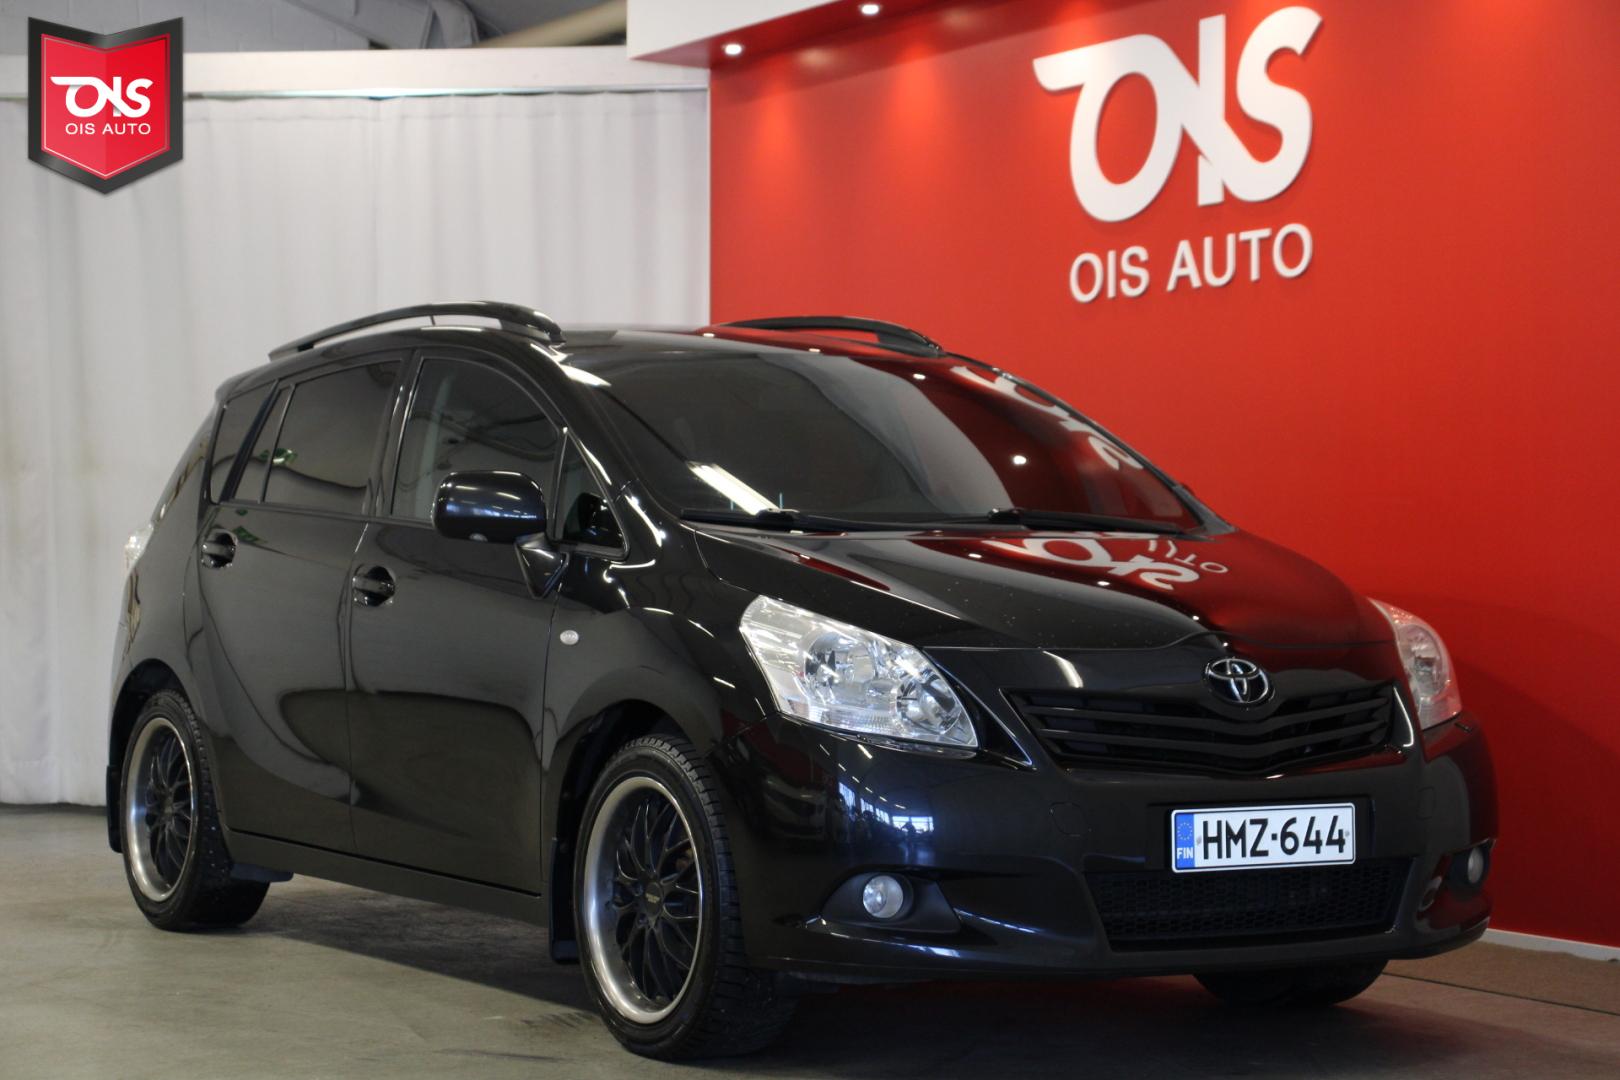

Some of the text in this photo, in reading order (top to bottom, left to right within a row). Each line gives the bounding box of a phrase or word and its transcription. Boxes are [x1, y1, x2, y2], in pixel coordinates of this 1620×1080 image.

[1032, 6, 1323, 222] OIS
[1069, 223, 1313, 303] OIS AUTO
[1176, 847, 1194, 860] FIN
[1202, 815, 1346, 860] HMZ-644
